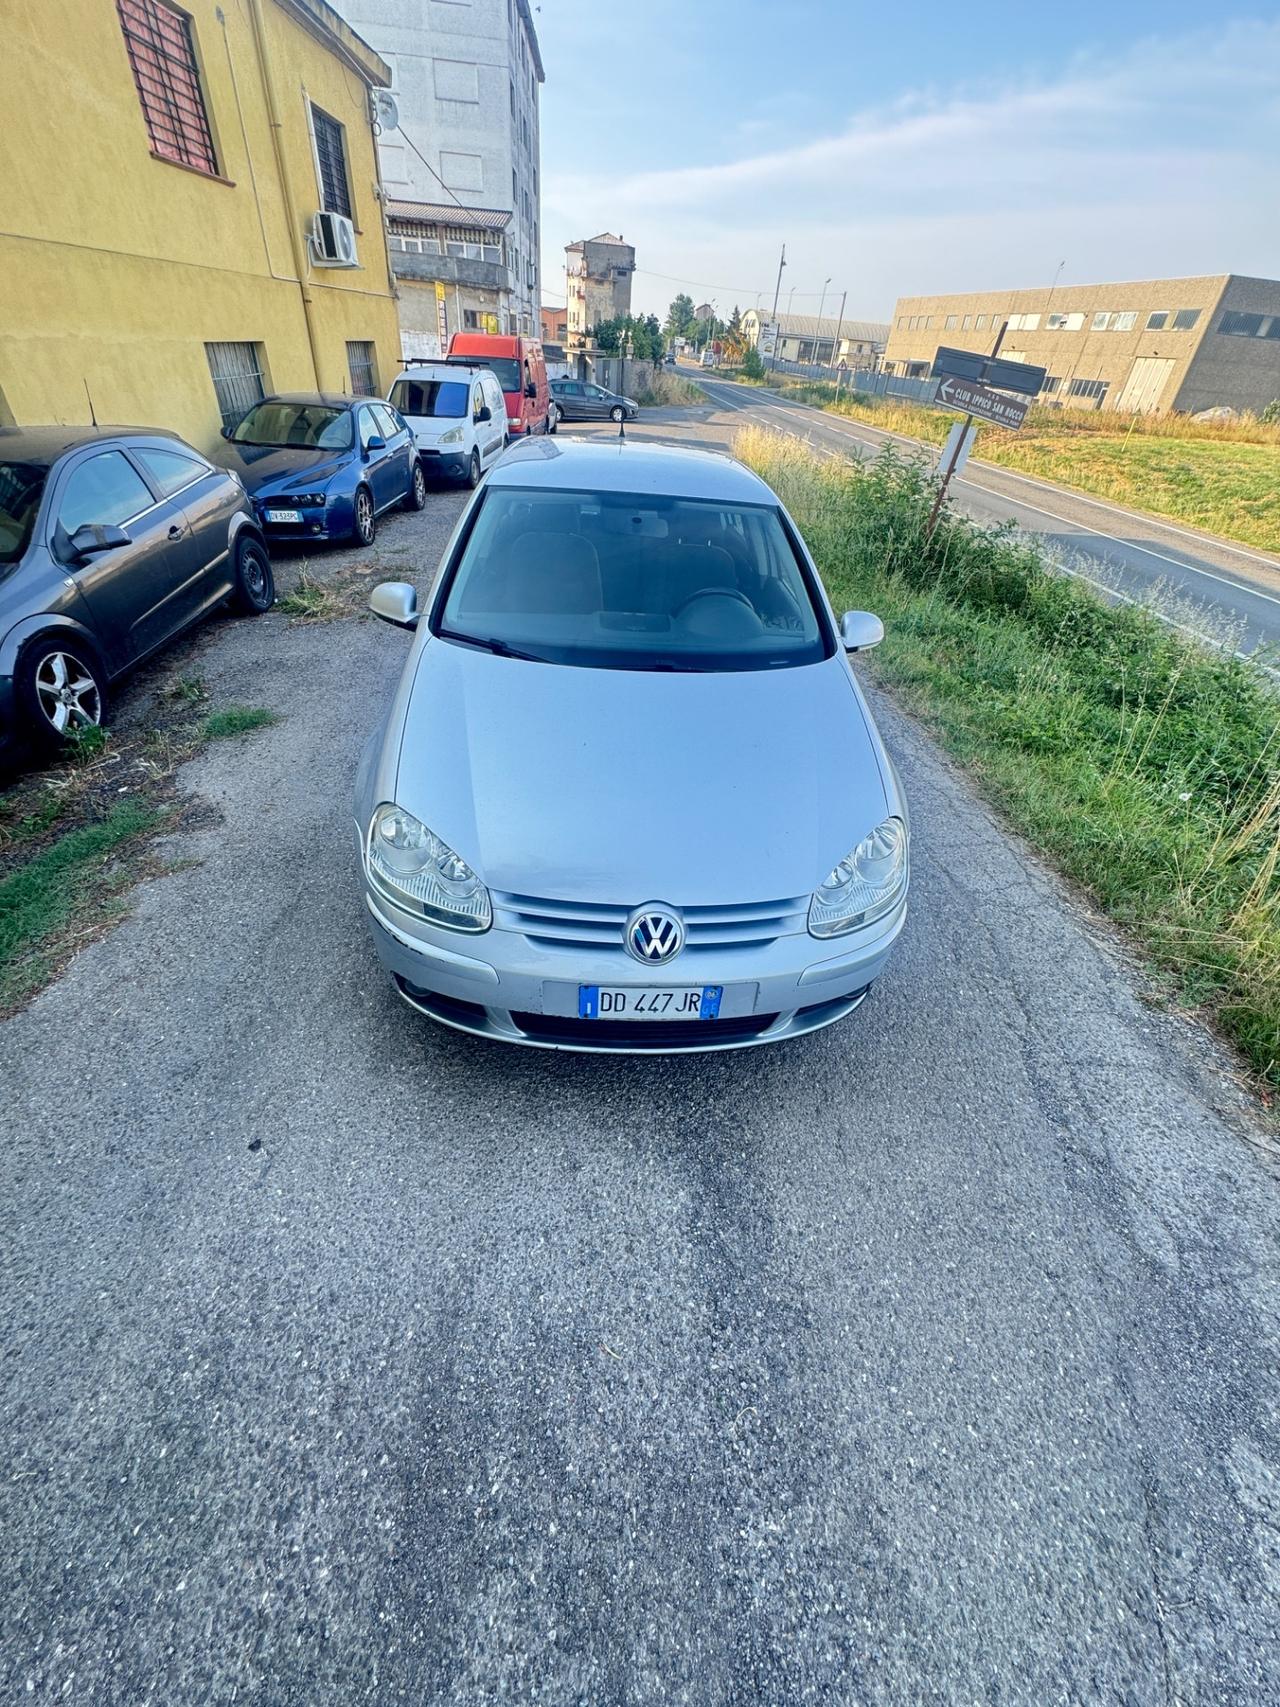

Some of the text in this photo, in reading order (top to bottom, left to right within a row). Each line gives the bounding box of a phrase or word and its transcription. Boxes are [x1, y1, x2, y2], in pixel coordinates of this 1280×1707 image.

[955, 388, 1024, 421] CLUB IPPICO SAN ROCCO
[600, 992, 626, 1012] DD
